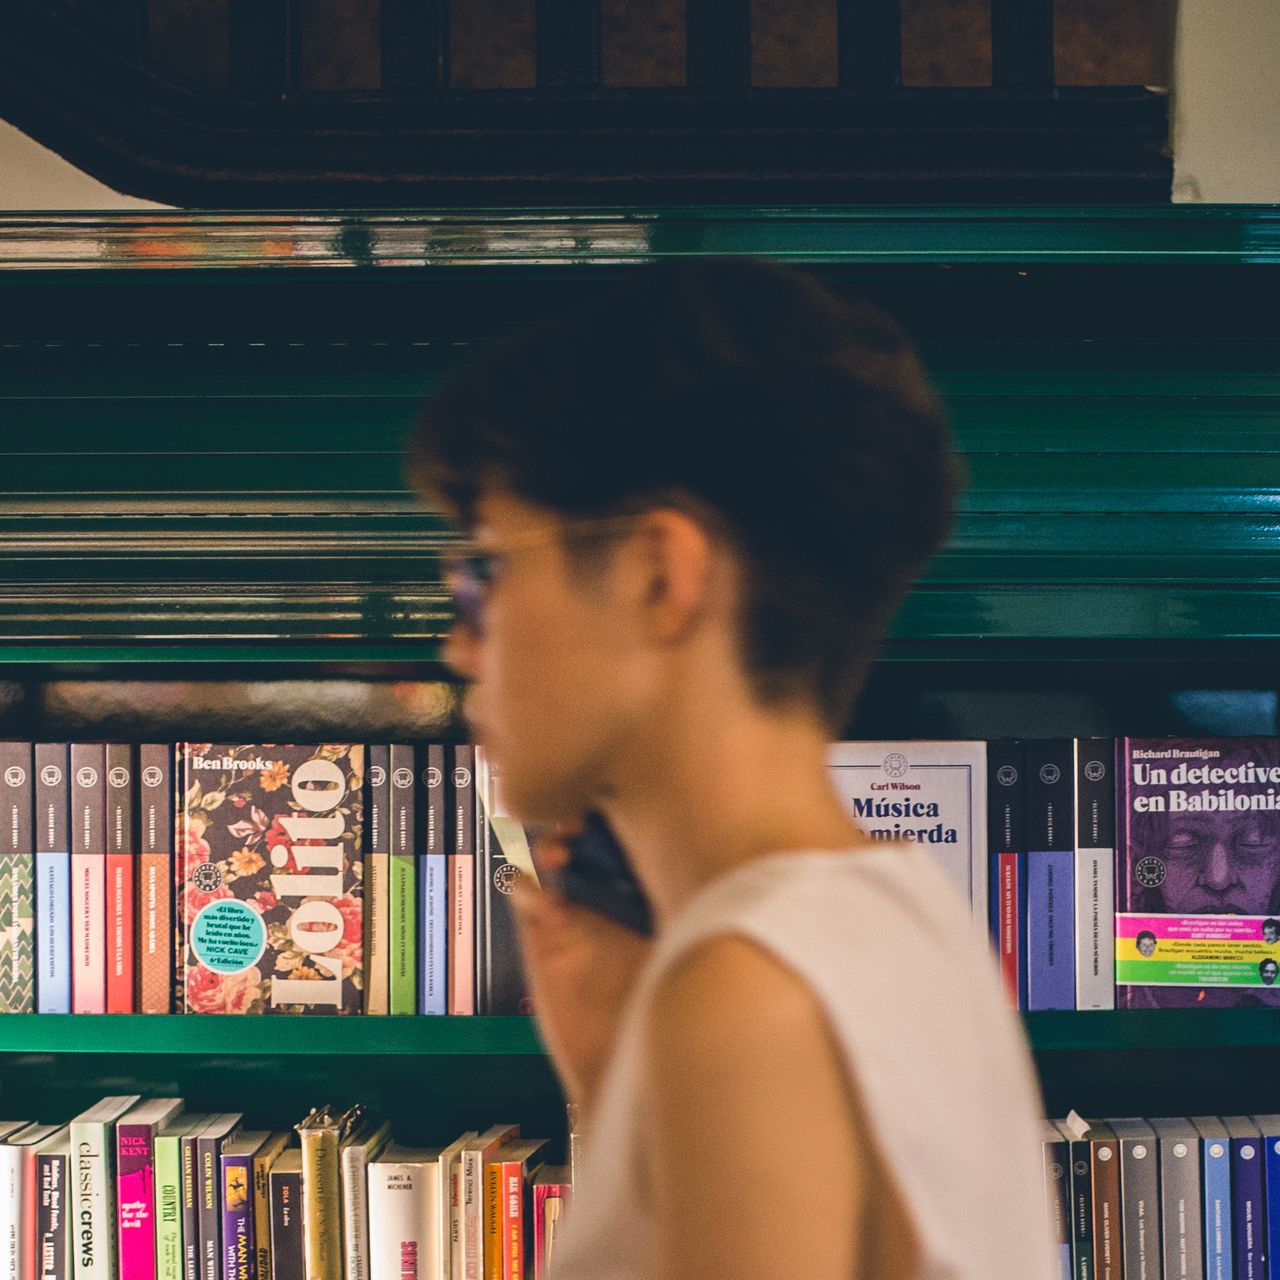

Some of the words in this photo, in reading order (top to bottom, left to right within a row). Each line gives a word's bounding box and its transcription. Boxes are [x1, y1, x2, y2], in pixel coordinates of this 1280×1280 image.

[193, 757, 220, 770] Ben
[222, 756, 272, 771] Brooks
[1132, 750, 1171, 760] Richard
[1172, 749, 1220, 760] Brautigan
[1133, 764, 1168, 785] Un
[870, 782, 889, 791] Carl
[891, 782, 921, 791] Wilson
[853, 798, 939, 818] Música
[1133, 795, 1166, 812] en
[870, 823, 958, 844] mierda
[271, 760, 346, 1009] Lolito
[227, 947, 248, 955] CAVE
[121, 1136, 146, 1145] NICK
[121, 1146, 149, 1155] KENT
[204, 1153, 212, 1177] COLIN
[162, 1185, 176, 1223] COUNTRY
[205, 1179, 213, 1209] WILSON
[237, 1217, 245, 1233] THE
[227, 1245, 235, 1267] WITH
[238, 1234, 248, 1263] MAN
